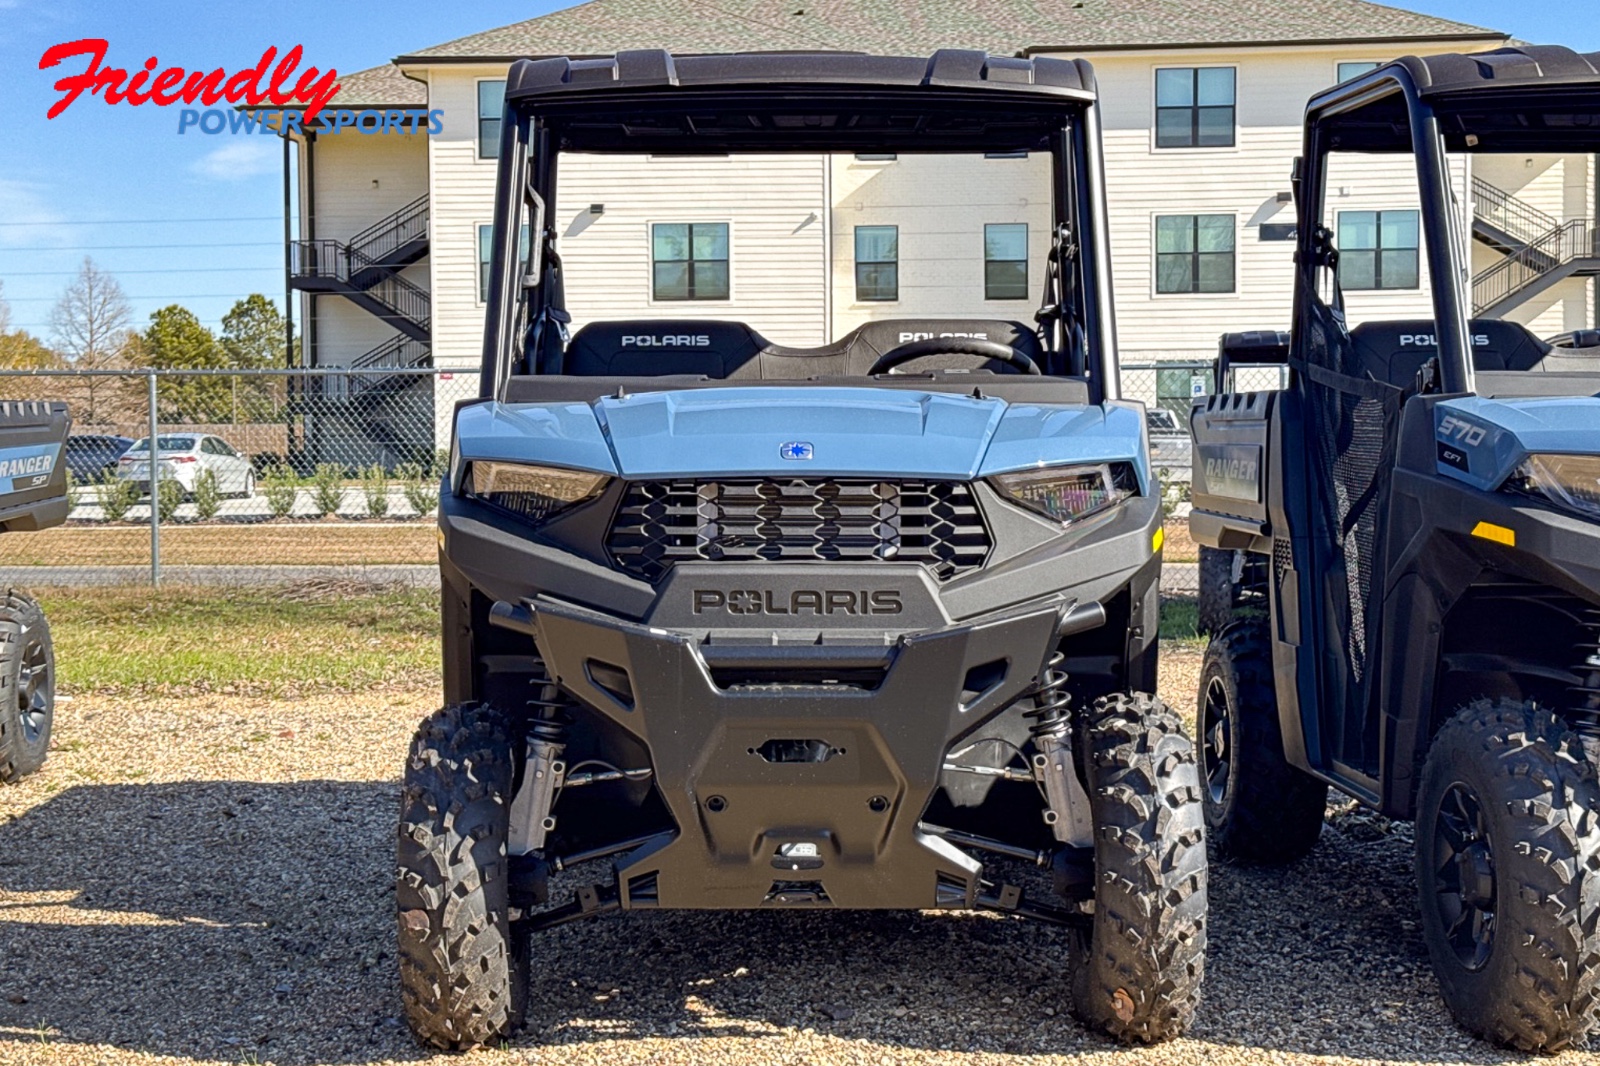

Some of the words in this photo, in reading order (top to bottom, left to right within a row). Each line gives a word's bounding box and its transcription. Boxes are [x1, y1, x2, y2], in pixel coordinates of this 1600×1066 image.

[621, 335, 710, 347] POLARIS
[1399, 334, 1490, 346] POLIS
[1443, 450, 1461, 463] EFI
[0, 455, 52, 478] RANGER
[1206, 457, 1257, 481] RANGER
[31, 475, 47, 486] SP
[693, 590, 903, 615] POLARIS
